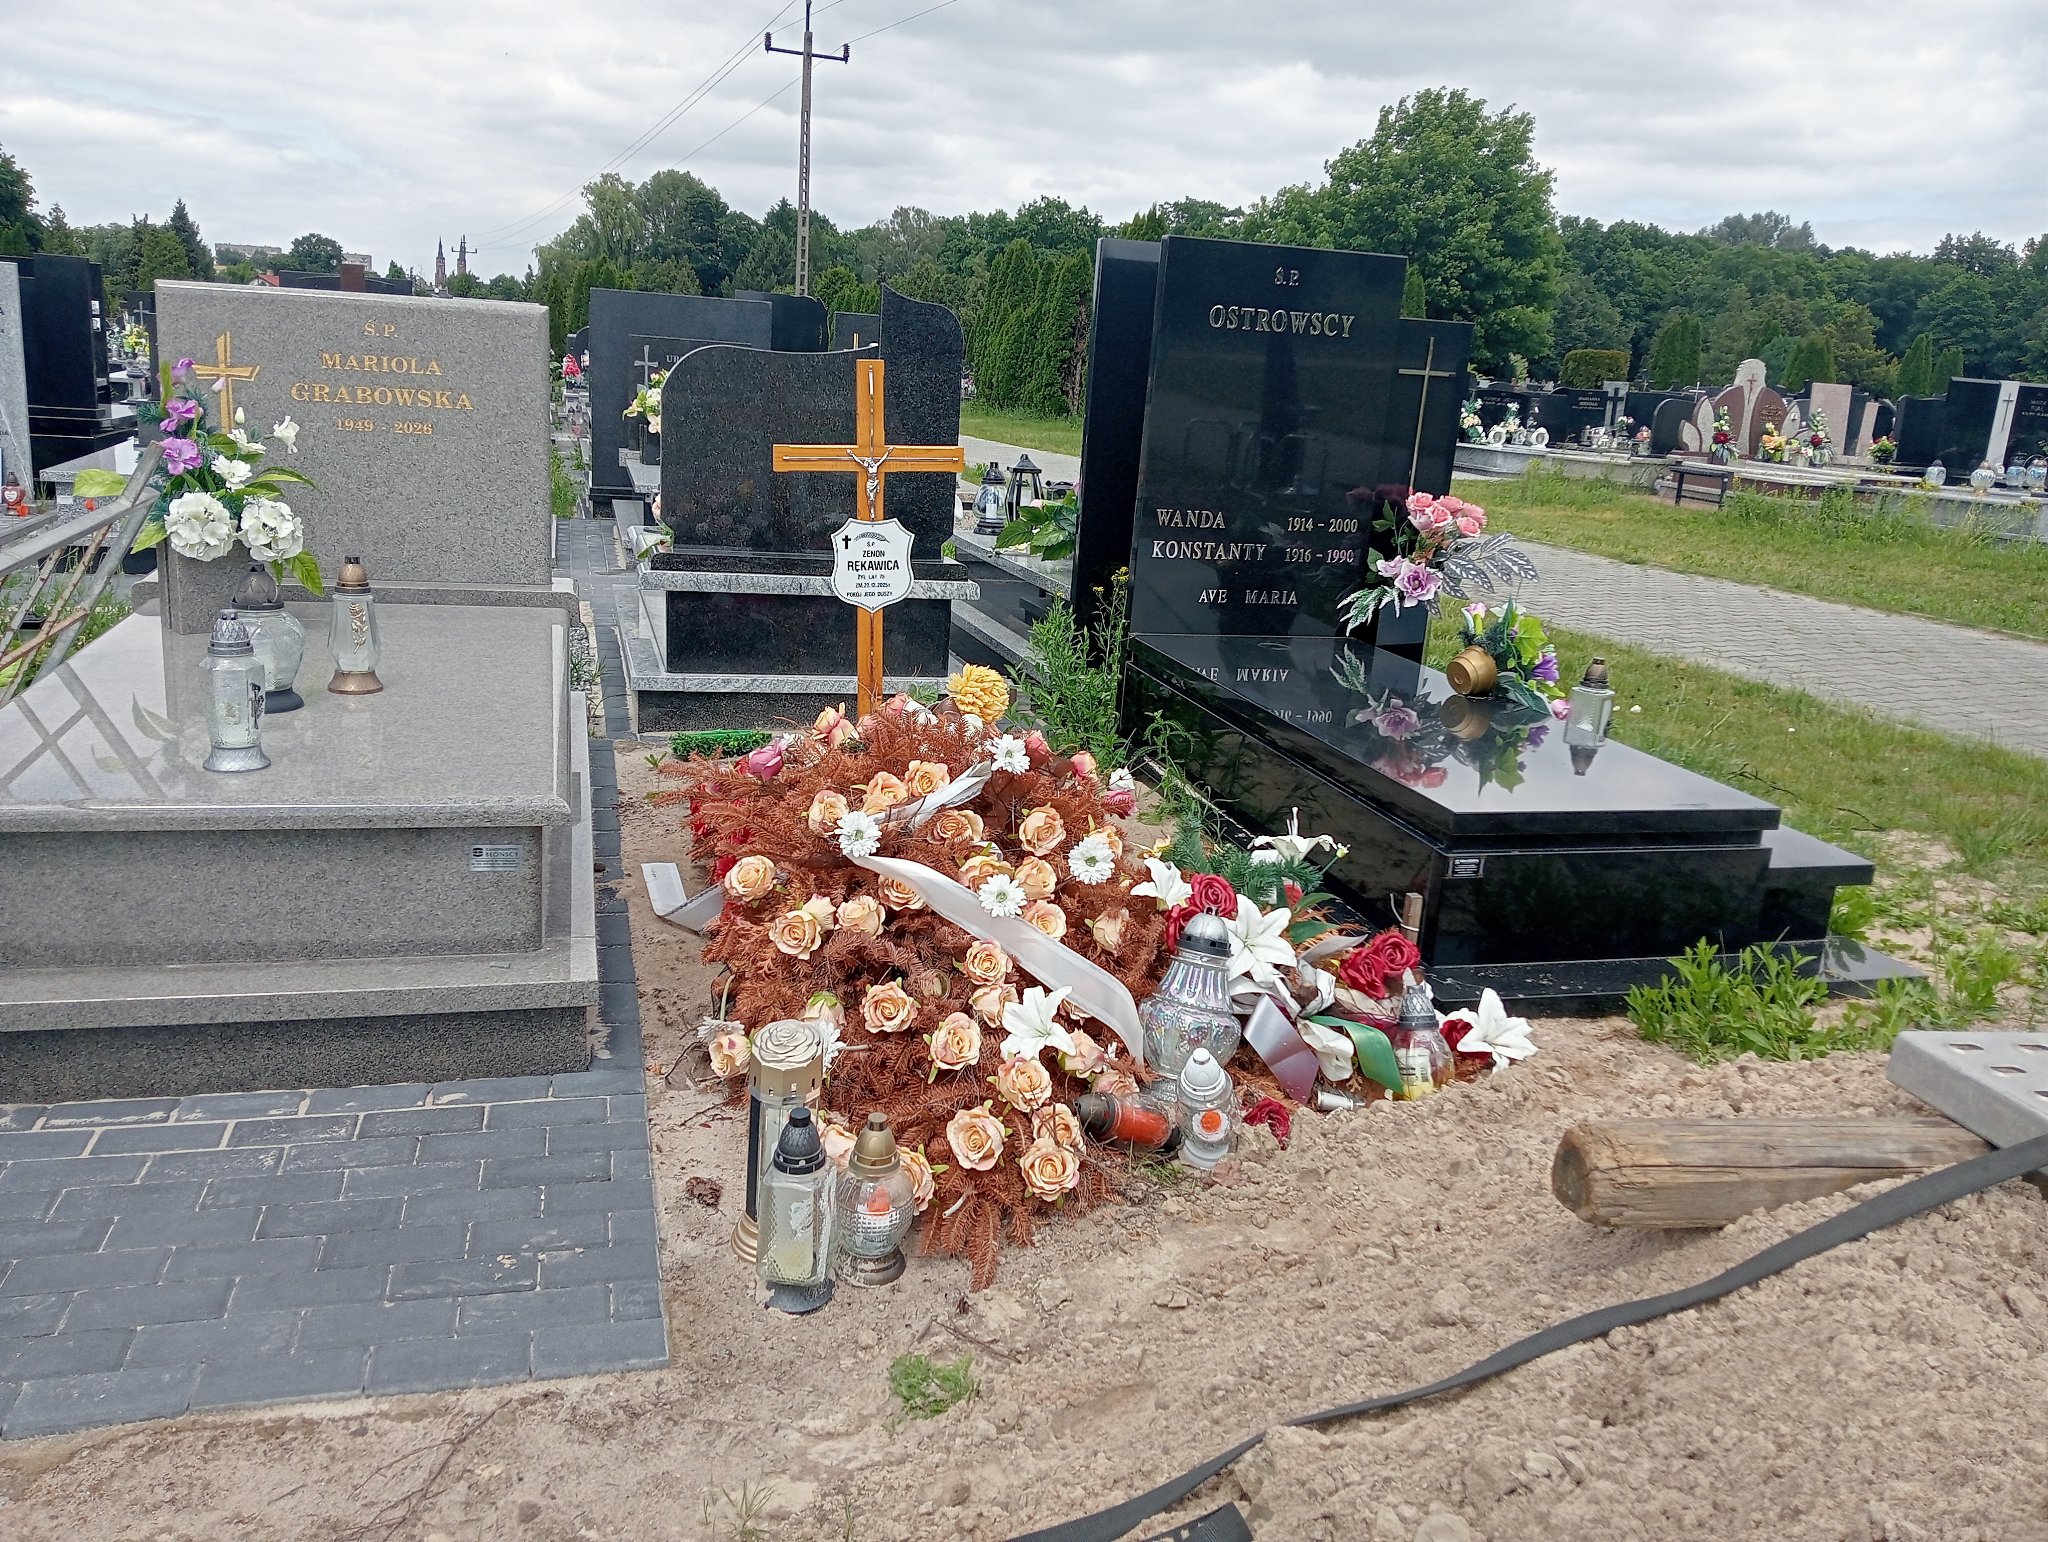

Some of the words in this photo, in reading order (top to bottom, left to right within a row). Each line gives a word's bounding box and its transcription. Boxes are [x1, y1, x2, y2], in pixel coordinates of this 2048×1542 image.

[1209, 304, 1356, 338] OSTROWSCY
[321, 352, 443, 376] MARIOLA
[290, 382, 475, 411] GRABOWSKA
[335, 418, 375, 432] 1949
[394, 420, 433, 435] 2026
[1156, 508, 1226, 529] WANDA
[1286, 516, 1314, 532] 1914
[1328, 518, 1359, 533] 2000
[1151, 540, 1267, 561] KONSTANTY
[1284, 548, 1312, 563] 1916
[1325, 549, 1354, 563] 1990
[847, 560, 899, 572] RĘKAWICA
[1198, 589, 1228, 604] AVE
[1244, 589, 1298, 605] MARIA
